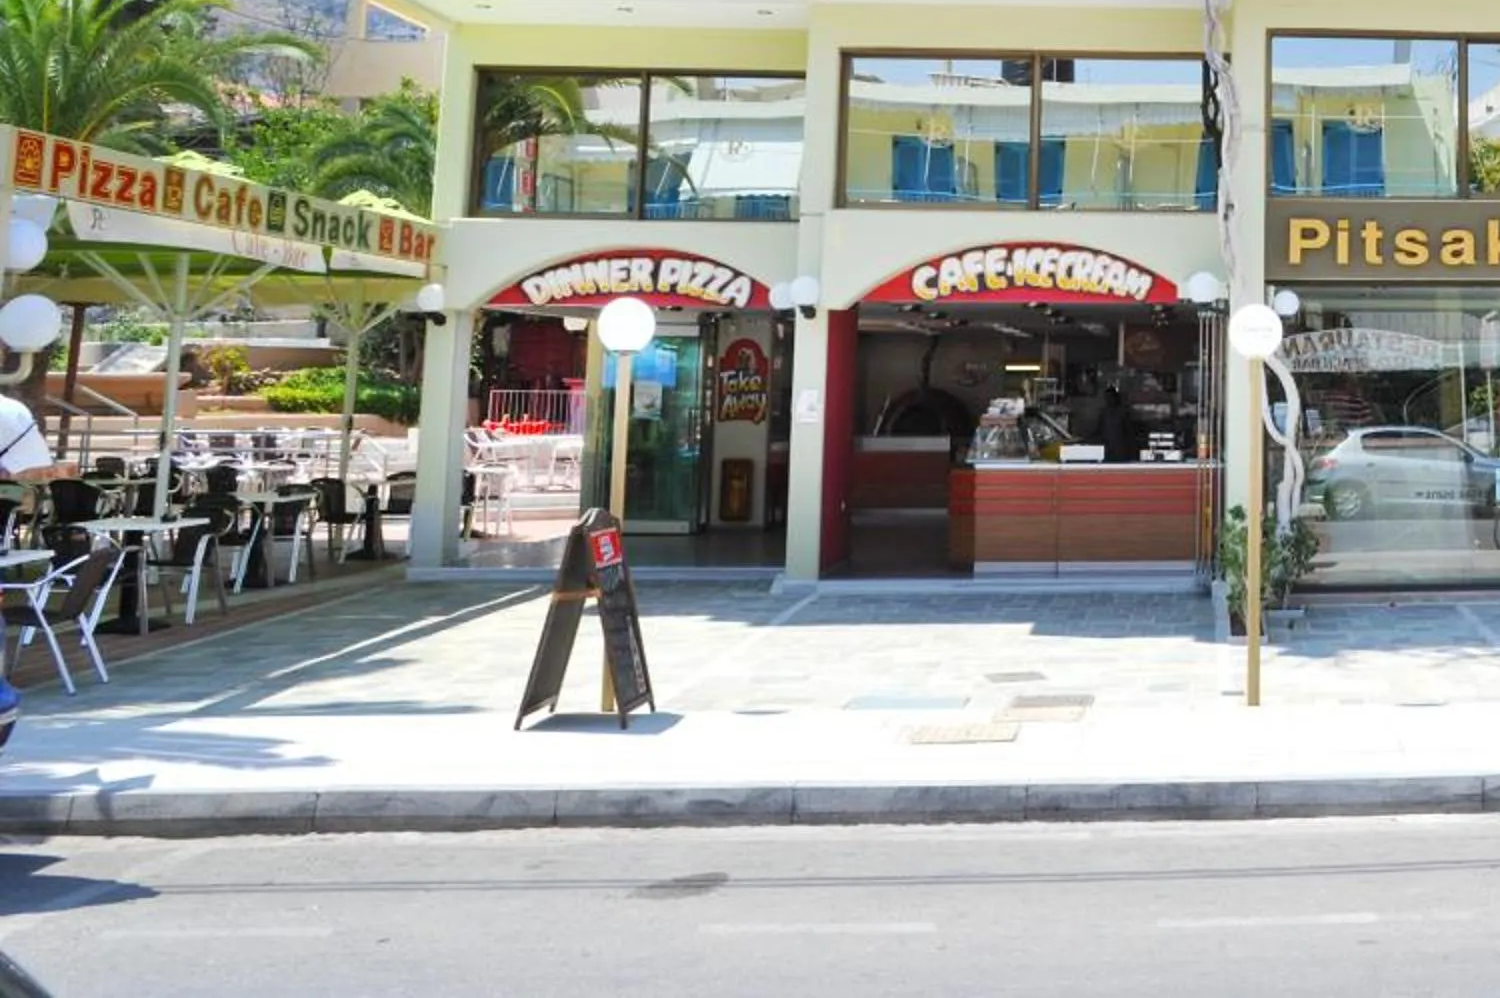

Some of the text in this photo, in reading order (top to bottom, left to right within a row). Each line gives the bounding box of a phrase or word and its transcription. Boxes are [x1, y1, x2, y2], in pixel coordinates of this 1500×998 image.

[48, 140, 437, 262] Pizza Cafe Snack Bar
[520, 257, 752, 308] DINNER PIZZA
[720, 370, 763, 394] Take
